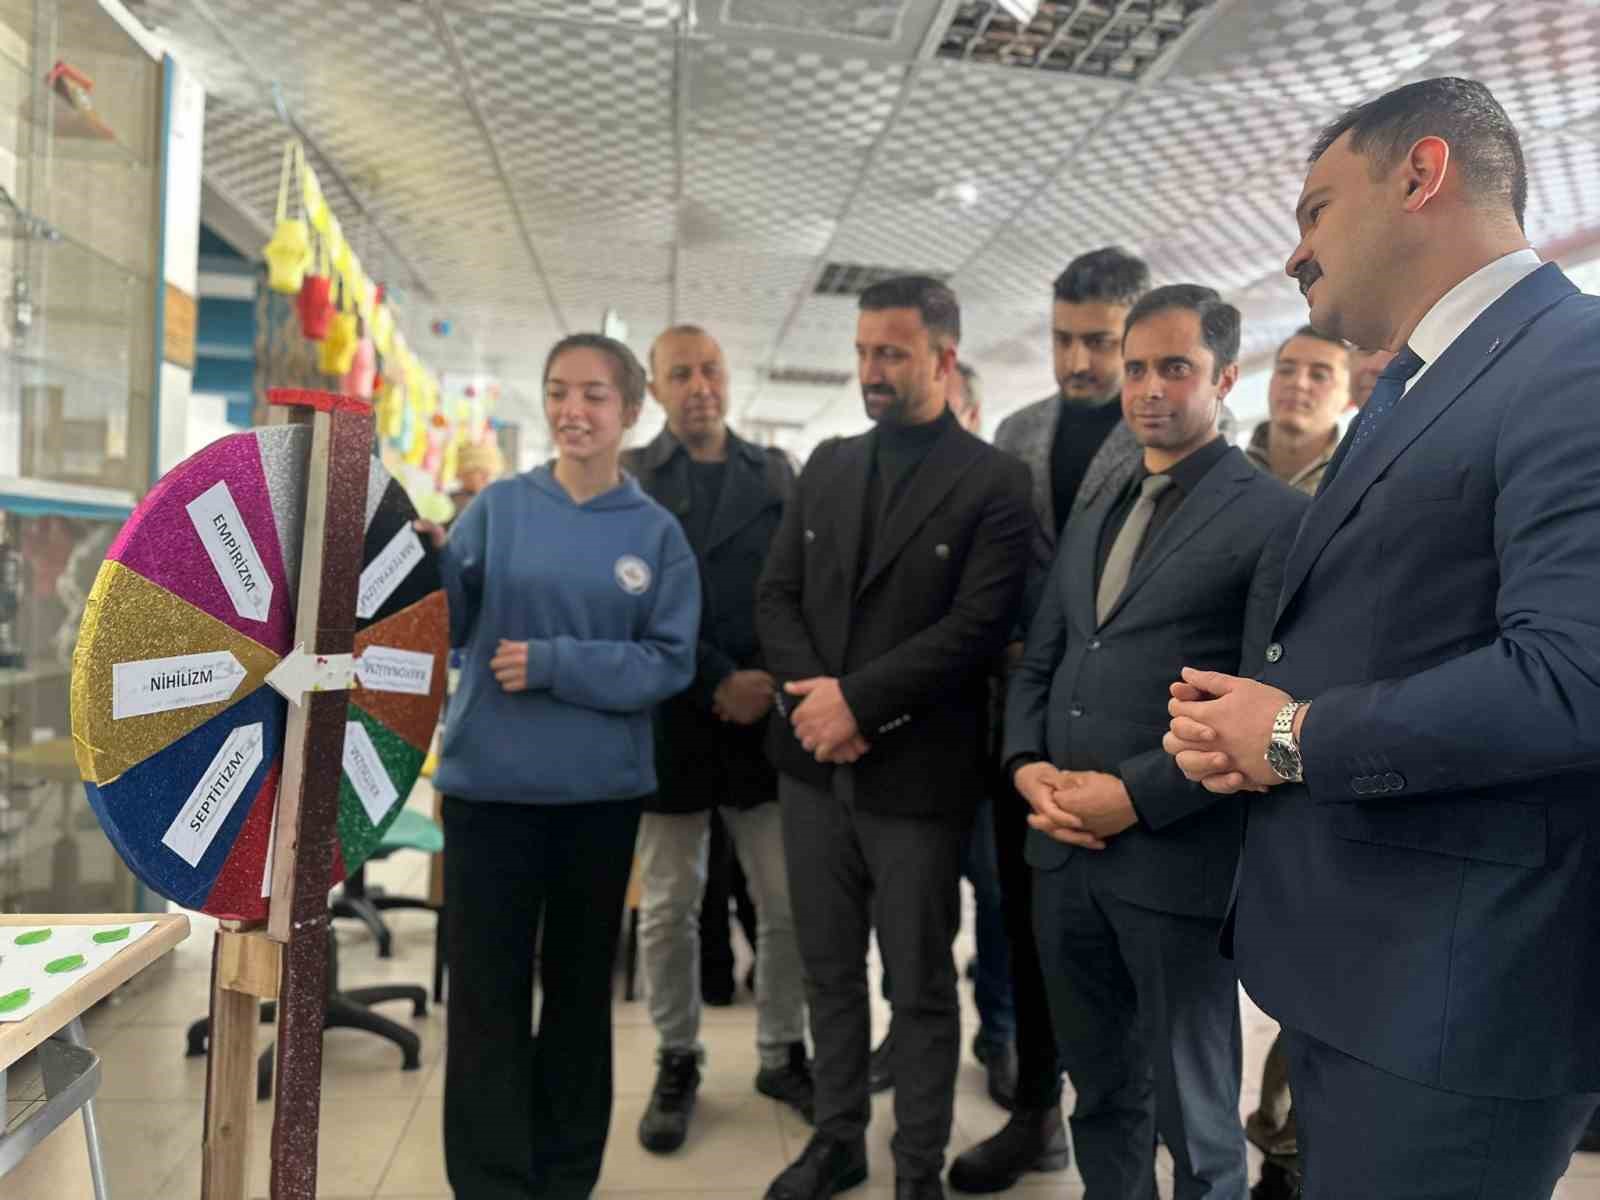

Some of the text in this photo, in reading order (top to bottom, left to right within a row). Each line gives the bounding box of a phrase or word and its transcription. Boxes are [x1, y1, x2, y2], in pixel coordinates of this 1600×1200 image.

[212, 513, 256, 593] EMPİRİZM
[150, 668, 214, 692] NİHİLİZM
[190, 751, 245, 833] SEPTİTİZM
